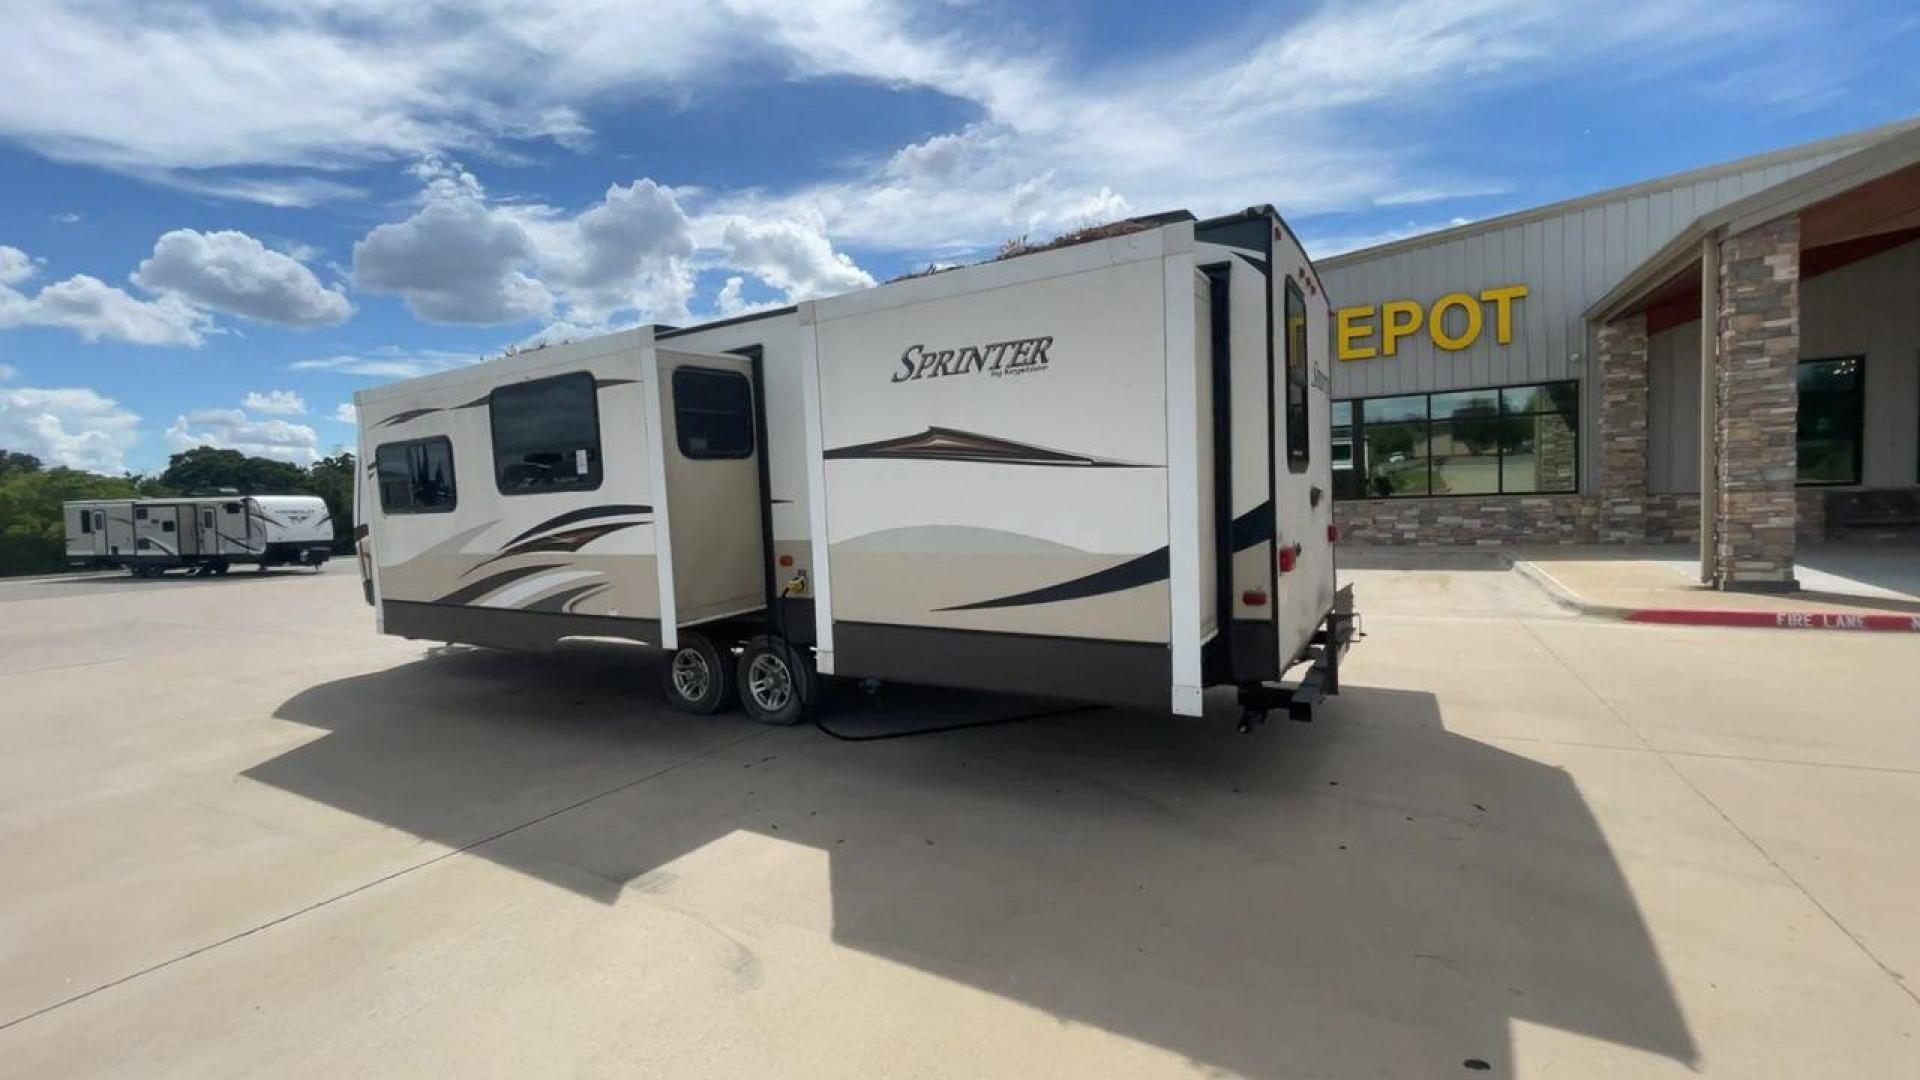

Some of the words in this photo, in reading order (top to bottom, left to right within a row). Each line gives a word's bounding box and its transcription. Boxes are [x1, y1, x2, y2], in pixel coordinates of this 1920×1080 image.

[1336, 284, 1529, 361] EPOT
[891, 335, 1053, 382] SPRINTER
[1776, 612, 1811, 628] FIRE
[1823, 613, 1864, 630] LANE
